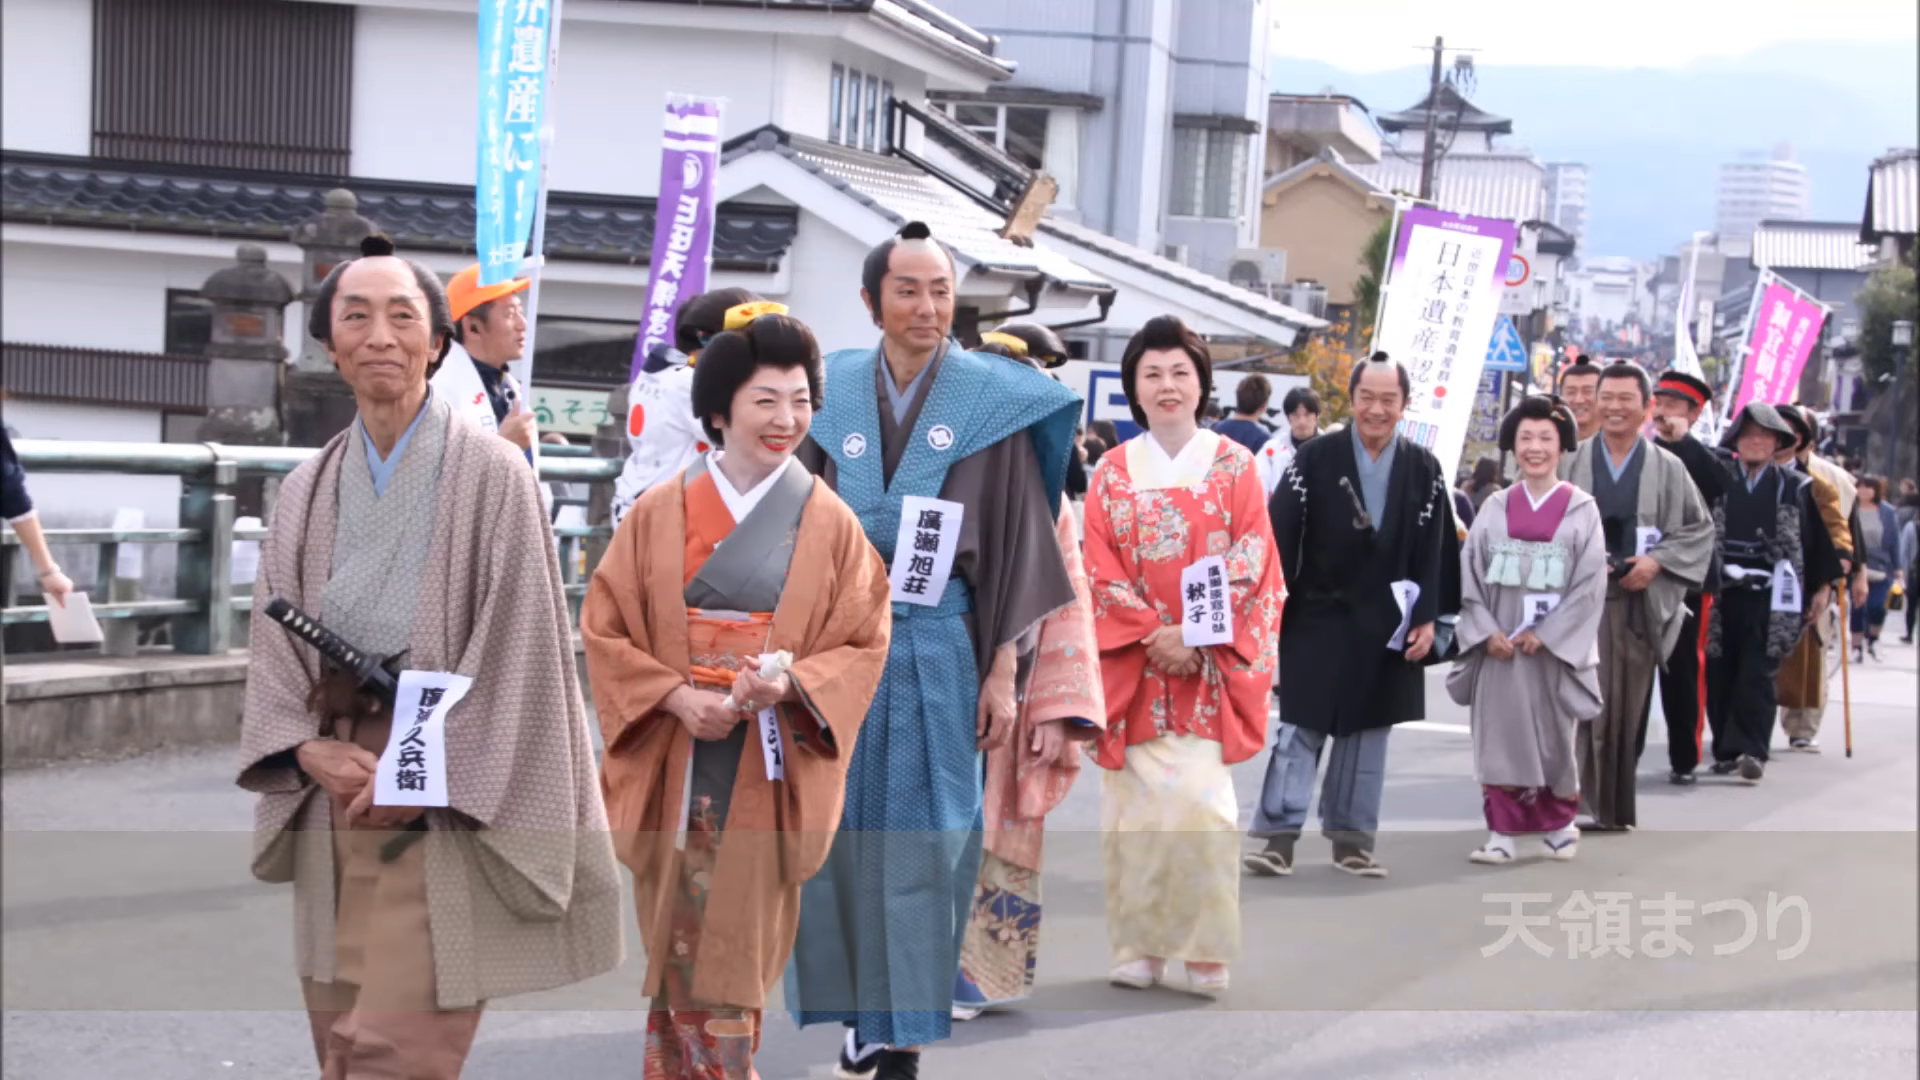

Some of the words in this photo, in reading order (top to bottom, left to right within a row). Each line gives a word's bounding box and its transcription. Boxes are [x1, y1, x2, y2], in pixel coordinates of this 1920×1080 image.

[1406, 241, 1461, 413] 日本遺産認定
[1185, 581, 1207, 624] 秋子
